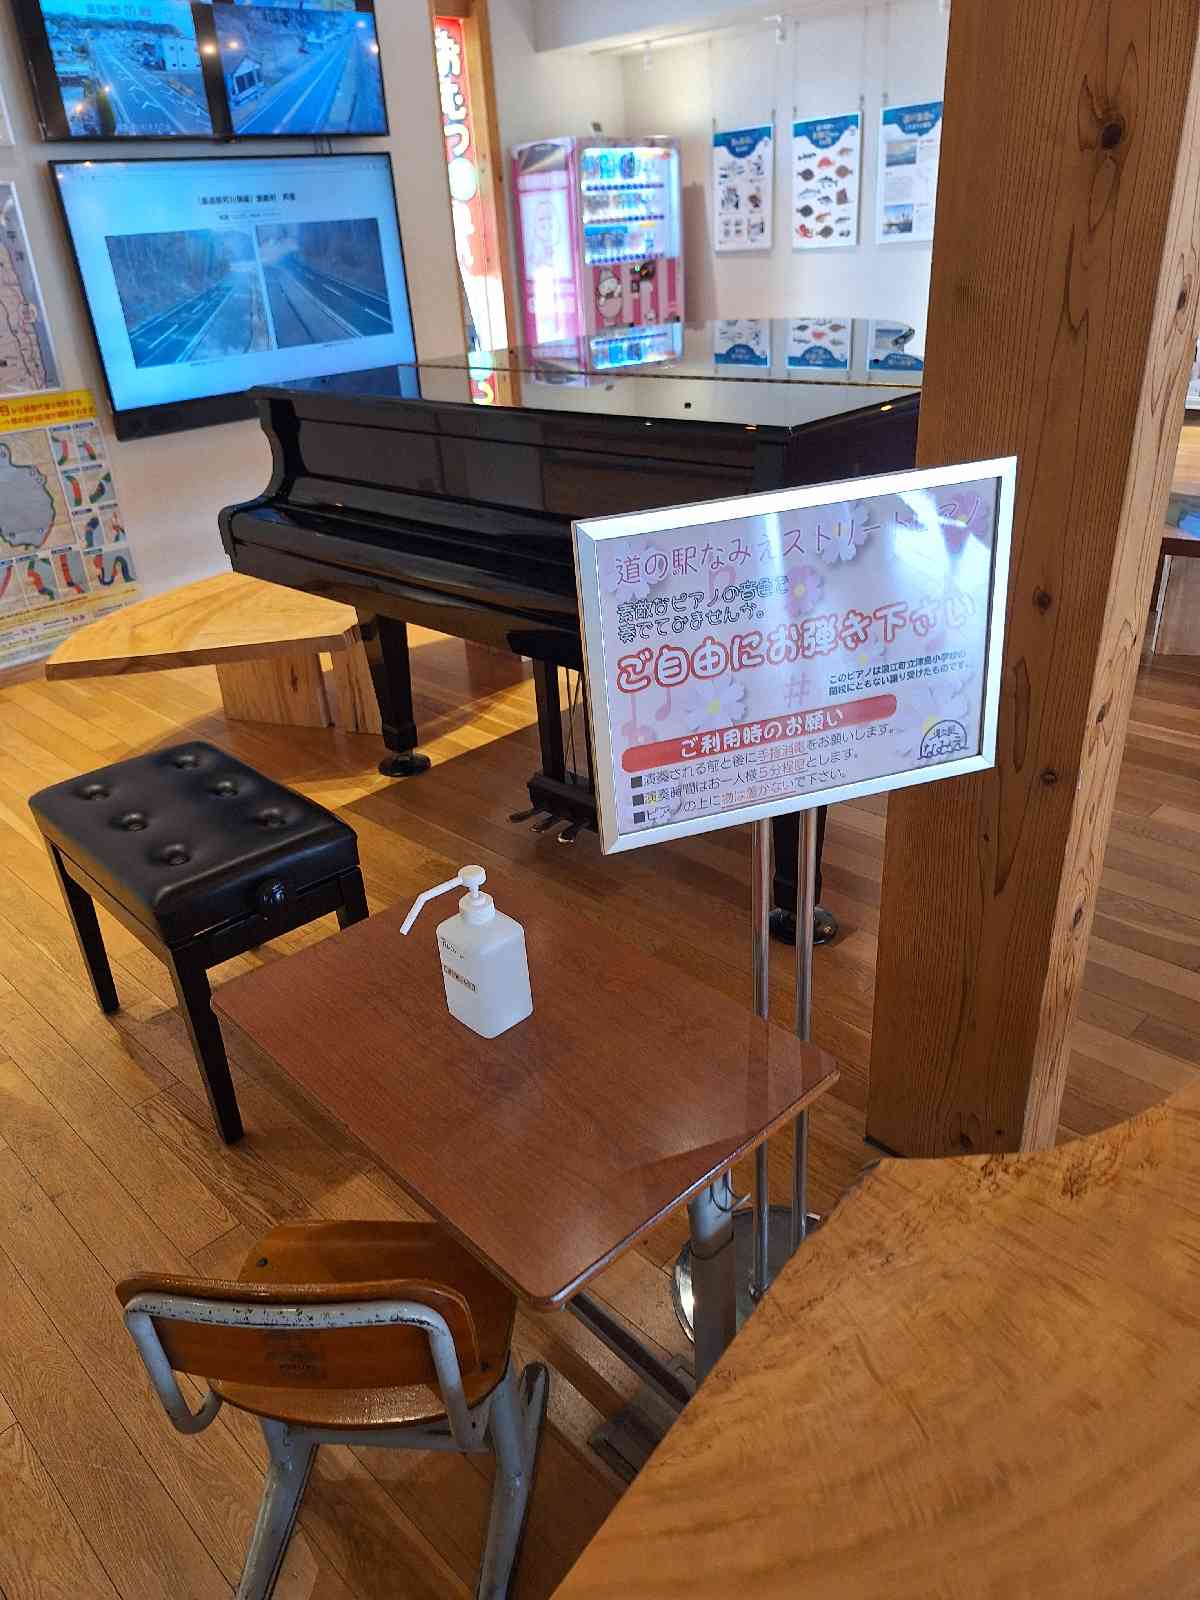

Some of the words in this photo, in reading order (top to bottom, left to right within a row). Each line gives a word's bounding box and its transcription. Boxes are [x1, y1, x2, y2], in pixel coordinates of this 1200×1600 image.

[615, 496, 981, 585] 道の駅なみえストリートアノ
[616, 593, 976, 693] ご自由にお弾き下さい
[680, 708, 843, 758] ご利用時のお願い
